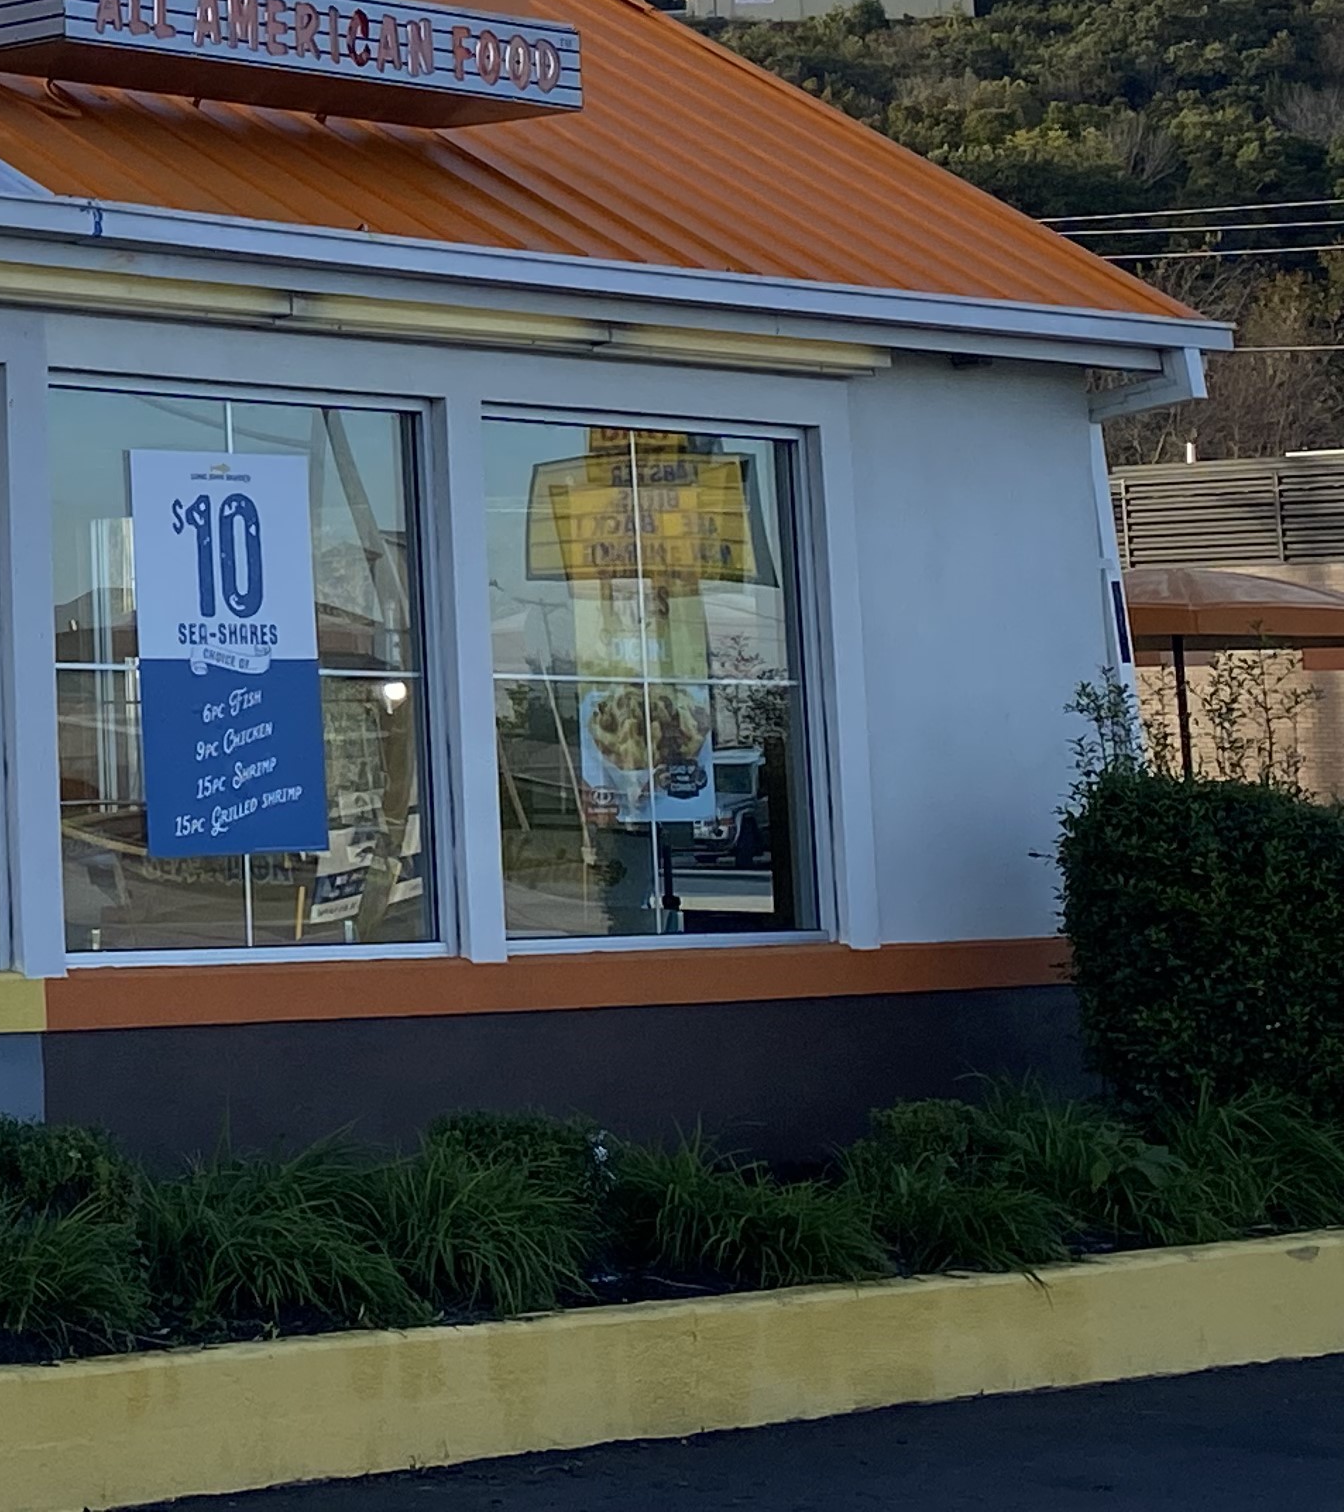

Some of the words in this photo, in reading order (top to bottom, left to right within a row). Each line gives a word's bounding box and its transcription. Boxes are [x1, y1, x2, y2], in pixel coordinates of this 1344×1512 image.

[451, 25, 560, 93] FOOD
[172, 492, 264, 619] $10
[178, 622, 278, 645] SEA-SHARES
